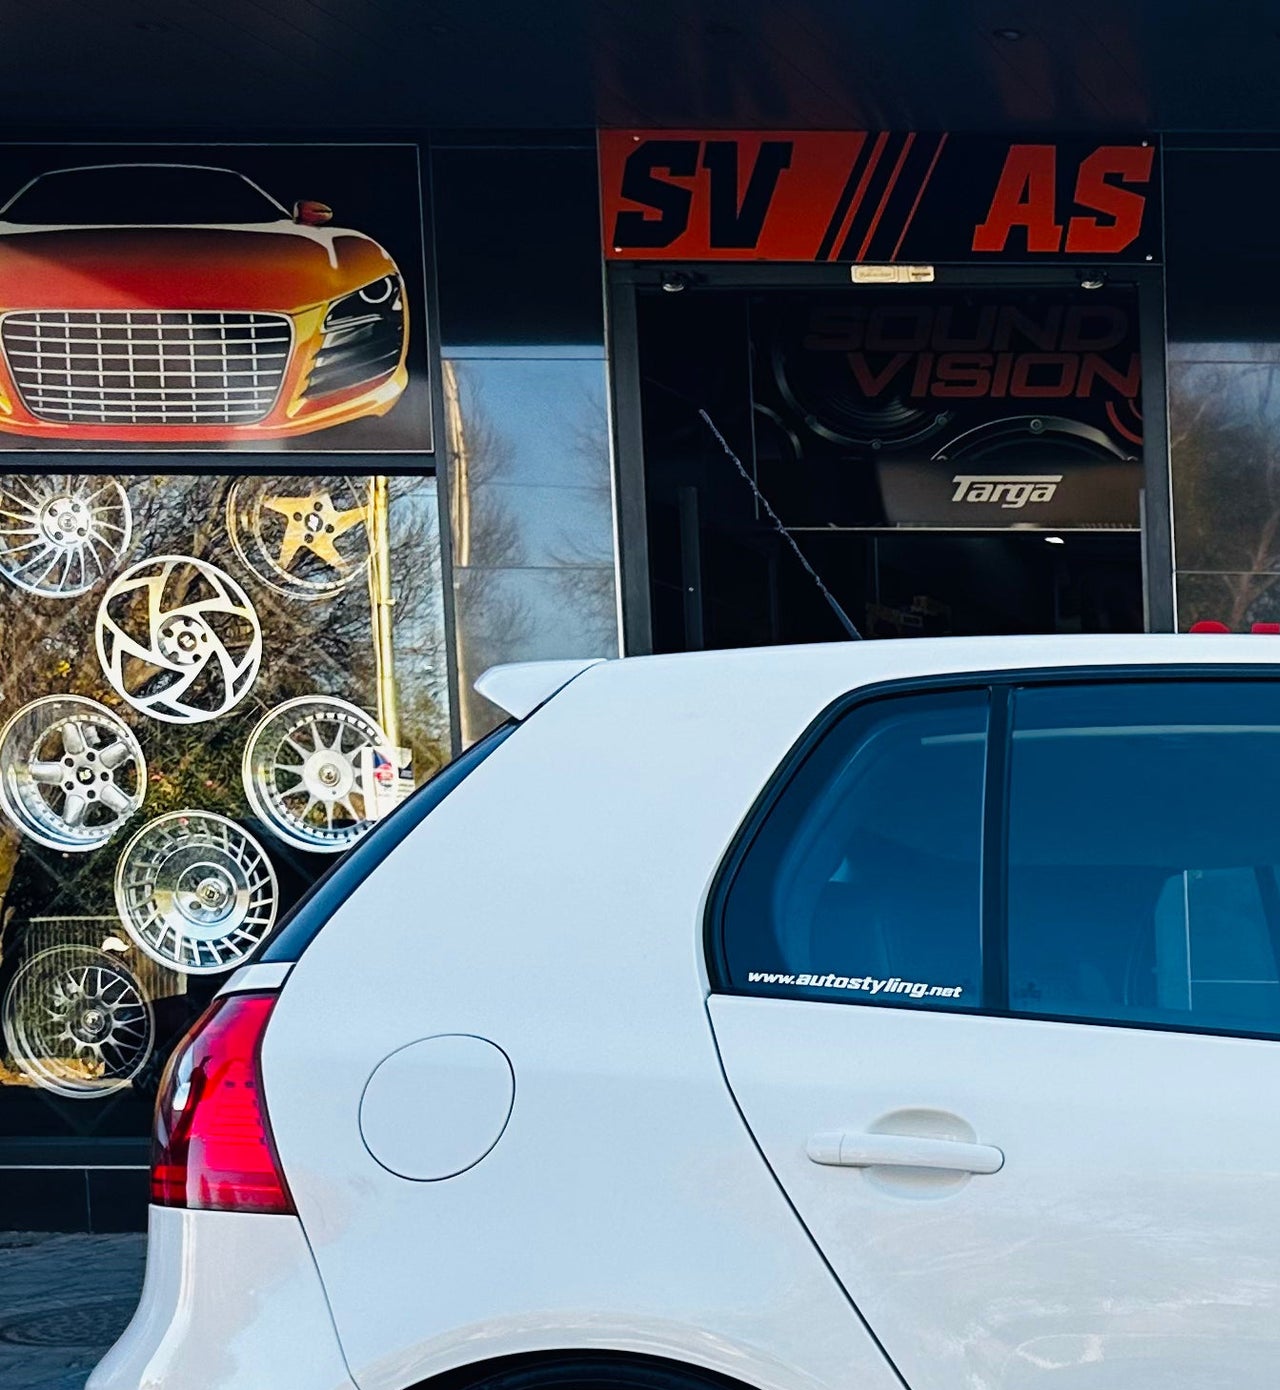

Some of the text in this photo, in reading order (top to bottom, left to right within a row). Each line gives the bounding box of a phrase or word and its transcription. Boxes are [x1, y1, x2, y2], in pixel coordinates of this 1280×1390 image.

[613, 139, 1155, 254] SV AS
[803, 303, 1129, 353] SOUND
[847, 352, 1143, 399] VISION
[952, 475, 1062, 508] Targa
[748, 971, 963, 998] www.autostyling.net
